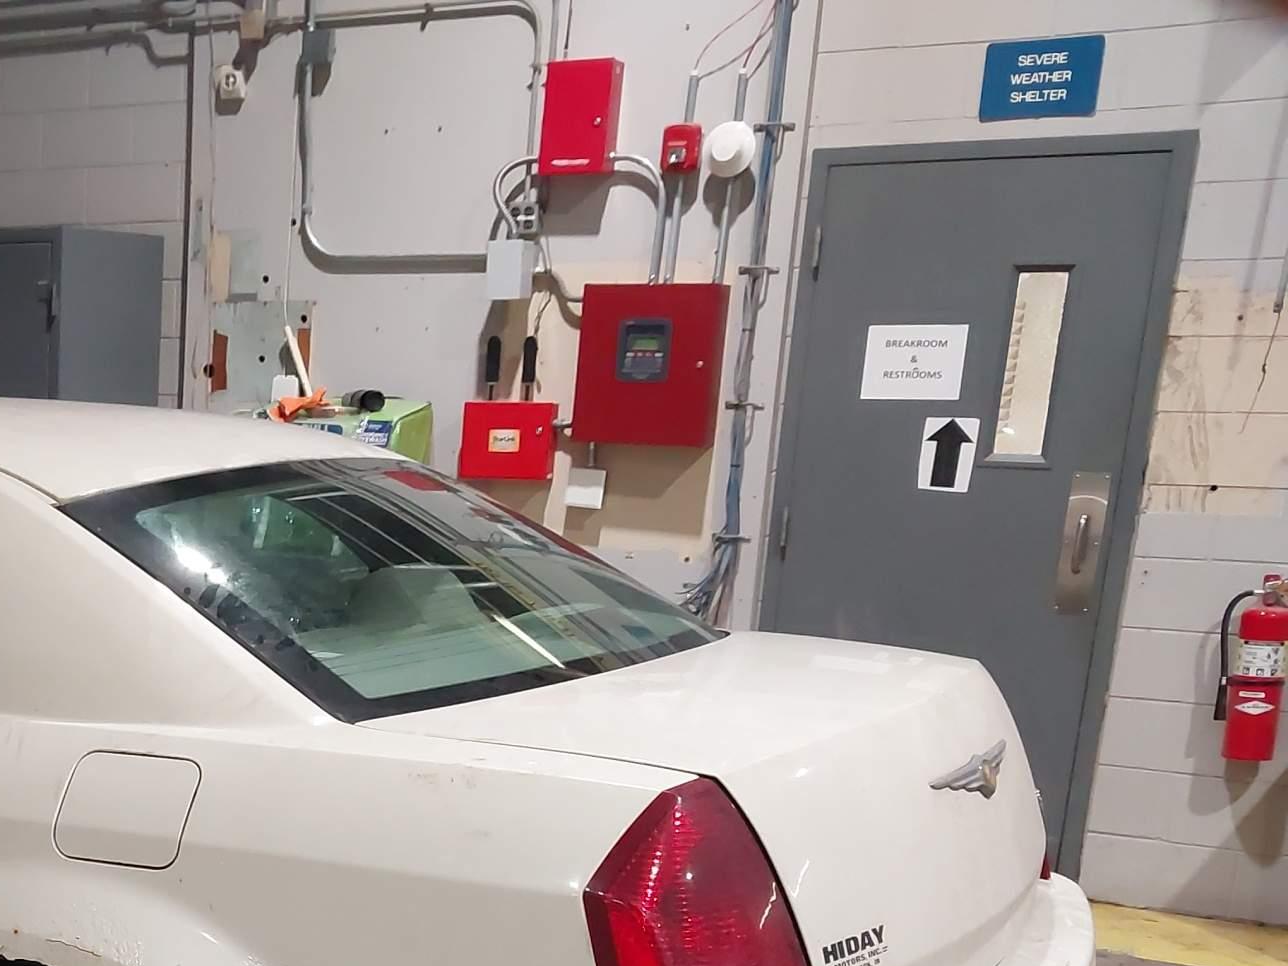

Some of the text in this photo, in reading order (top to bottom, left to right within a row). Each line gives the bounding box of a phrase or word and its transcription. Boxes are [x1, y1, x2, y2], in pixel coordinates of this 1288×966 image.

[1018, 52, 1069, 66] SEVERE
[1010, 70, 1073, 85] WEATHER
[1010, 88, 1067, 103] SHELTER
[885, 339, 948, 348] BREAKROOM
[910, 355, 918, 363] &
[822, 925, 884, 964] HIDAY
